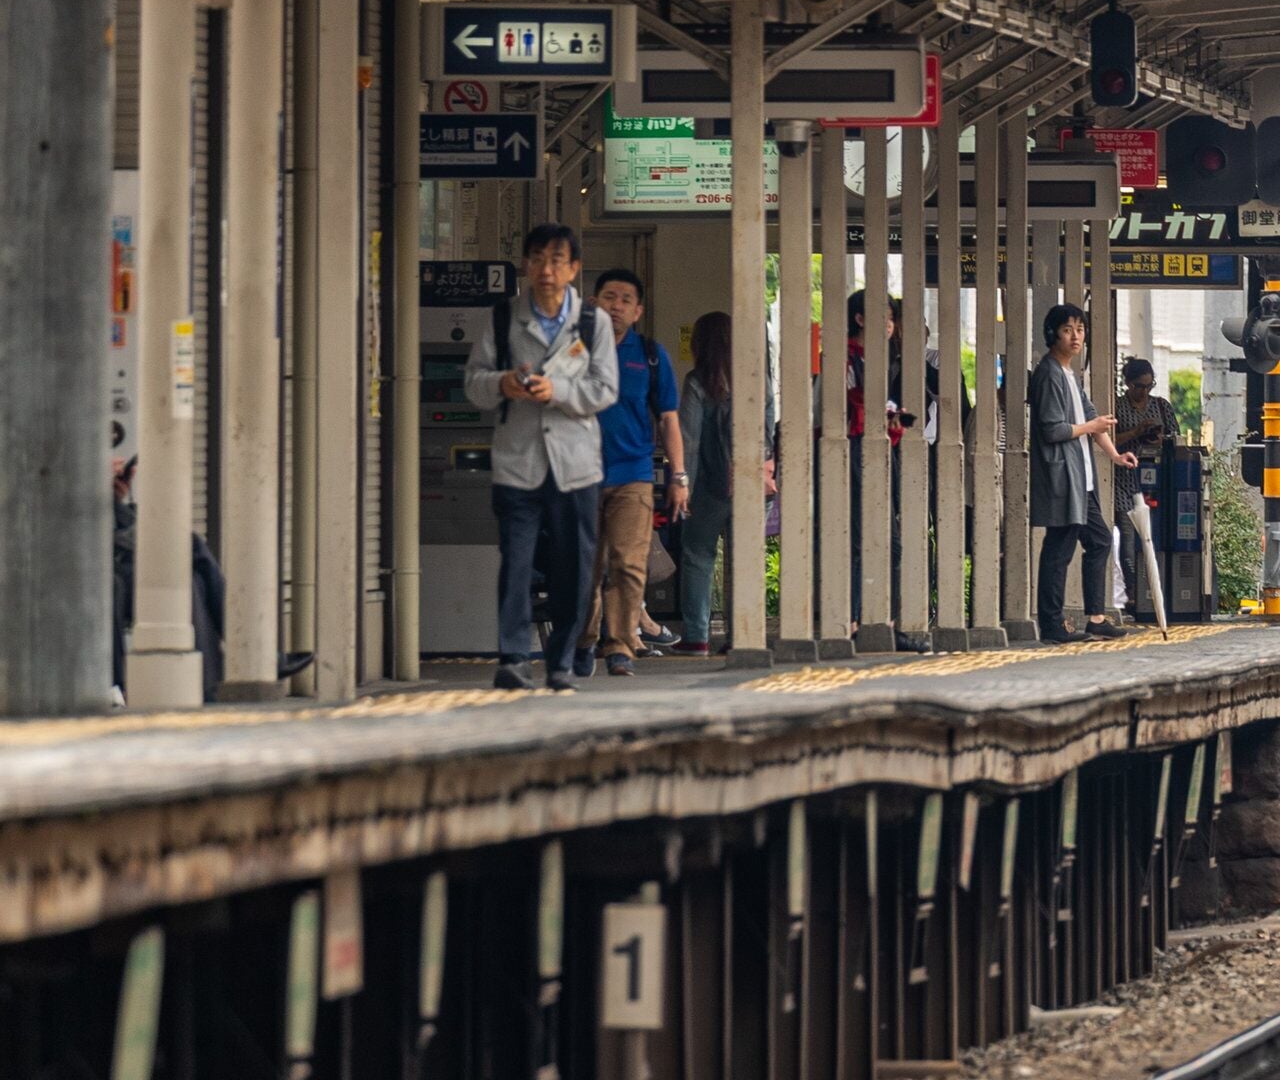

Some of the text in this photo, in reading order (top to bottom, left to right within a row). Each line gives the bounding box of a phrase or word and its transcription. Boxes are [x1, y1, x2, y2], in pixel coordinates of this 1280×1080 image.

[435, 273, 484, 286] よびだし
[491, 270, 502, 287] 2
[1144, 470, 1152, 480] 4
[612, 934, 641, 1002] 1
